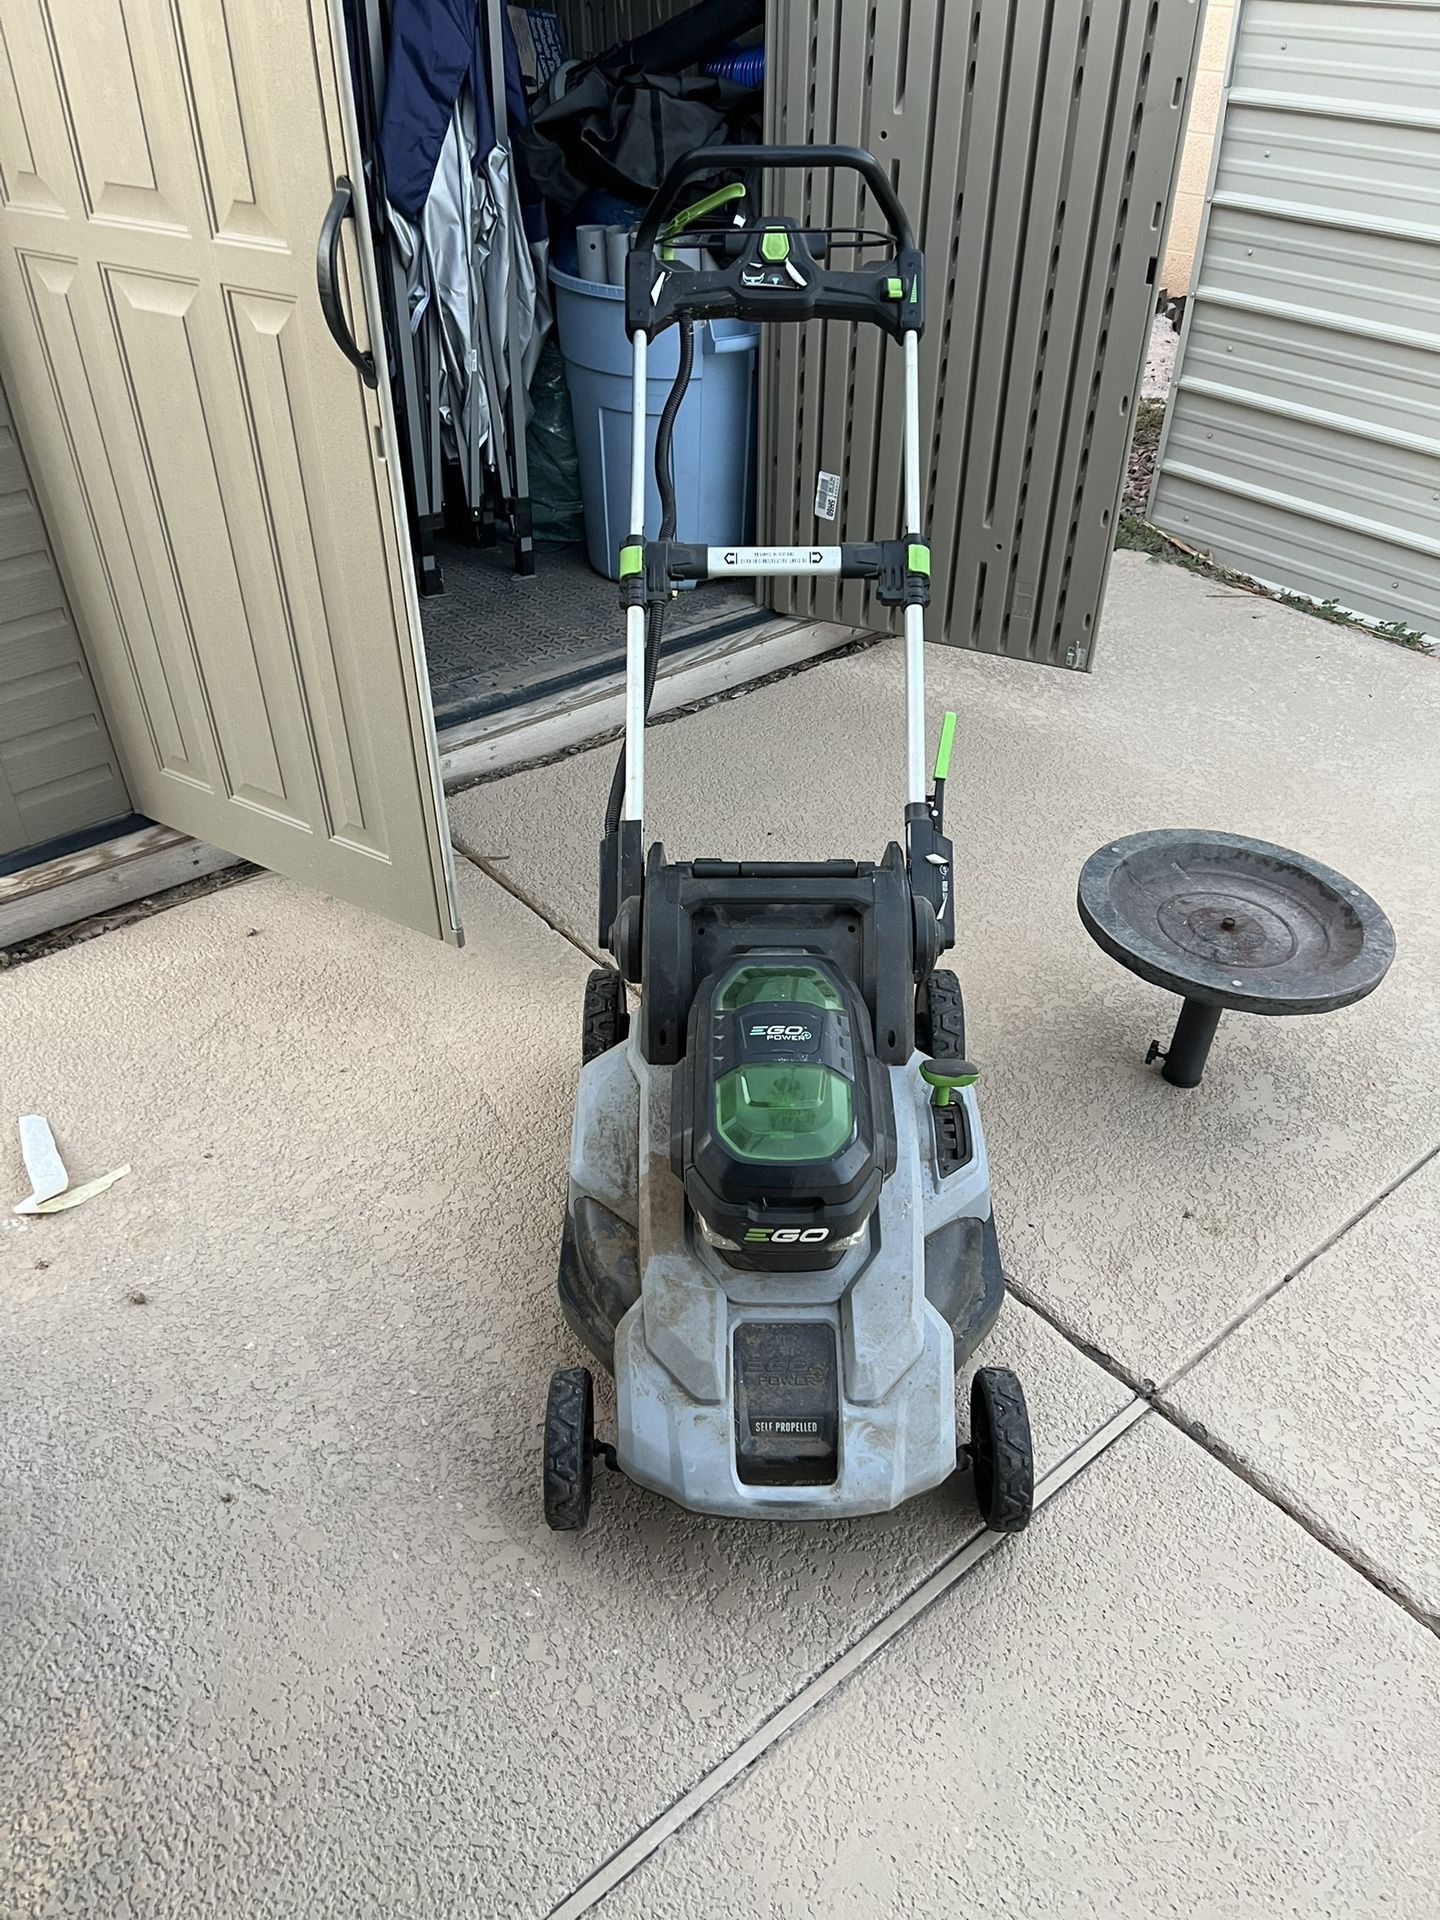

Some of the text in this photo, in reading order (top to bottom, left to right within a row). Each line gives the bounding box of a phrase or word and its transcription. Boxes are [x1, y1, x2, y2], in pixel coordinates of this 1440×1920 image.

[750, 1025, 804, 1036] EGO
[744, 1228, 830, 1243] EGO
[755, 1422, 818, 1432] SELF PROPELLED
